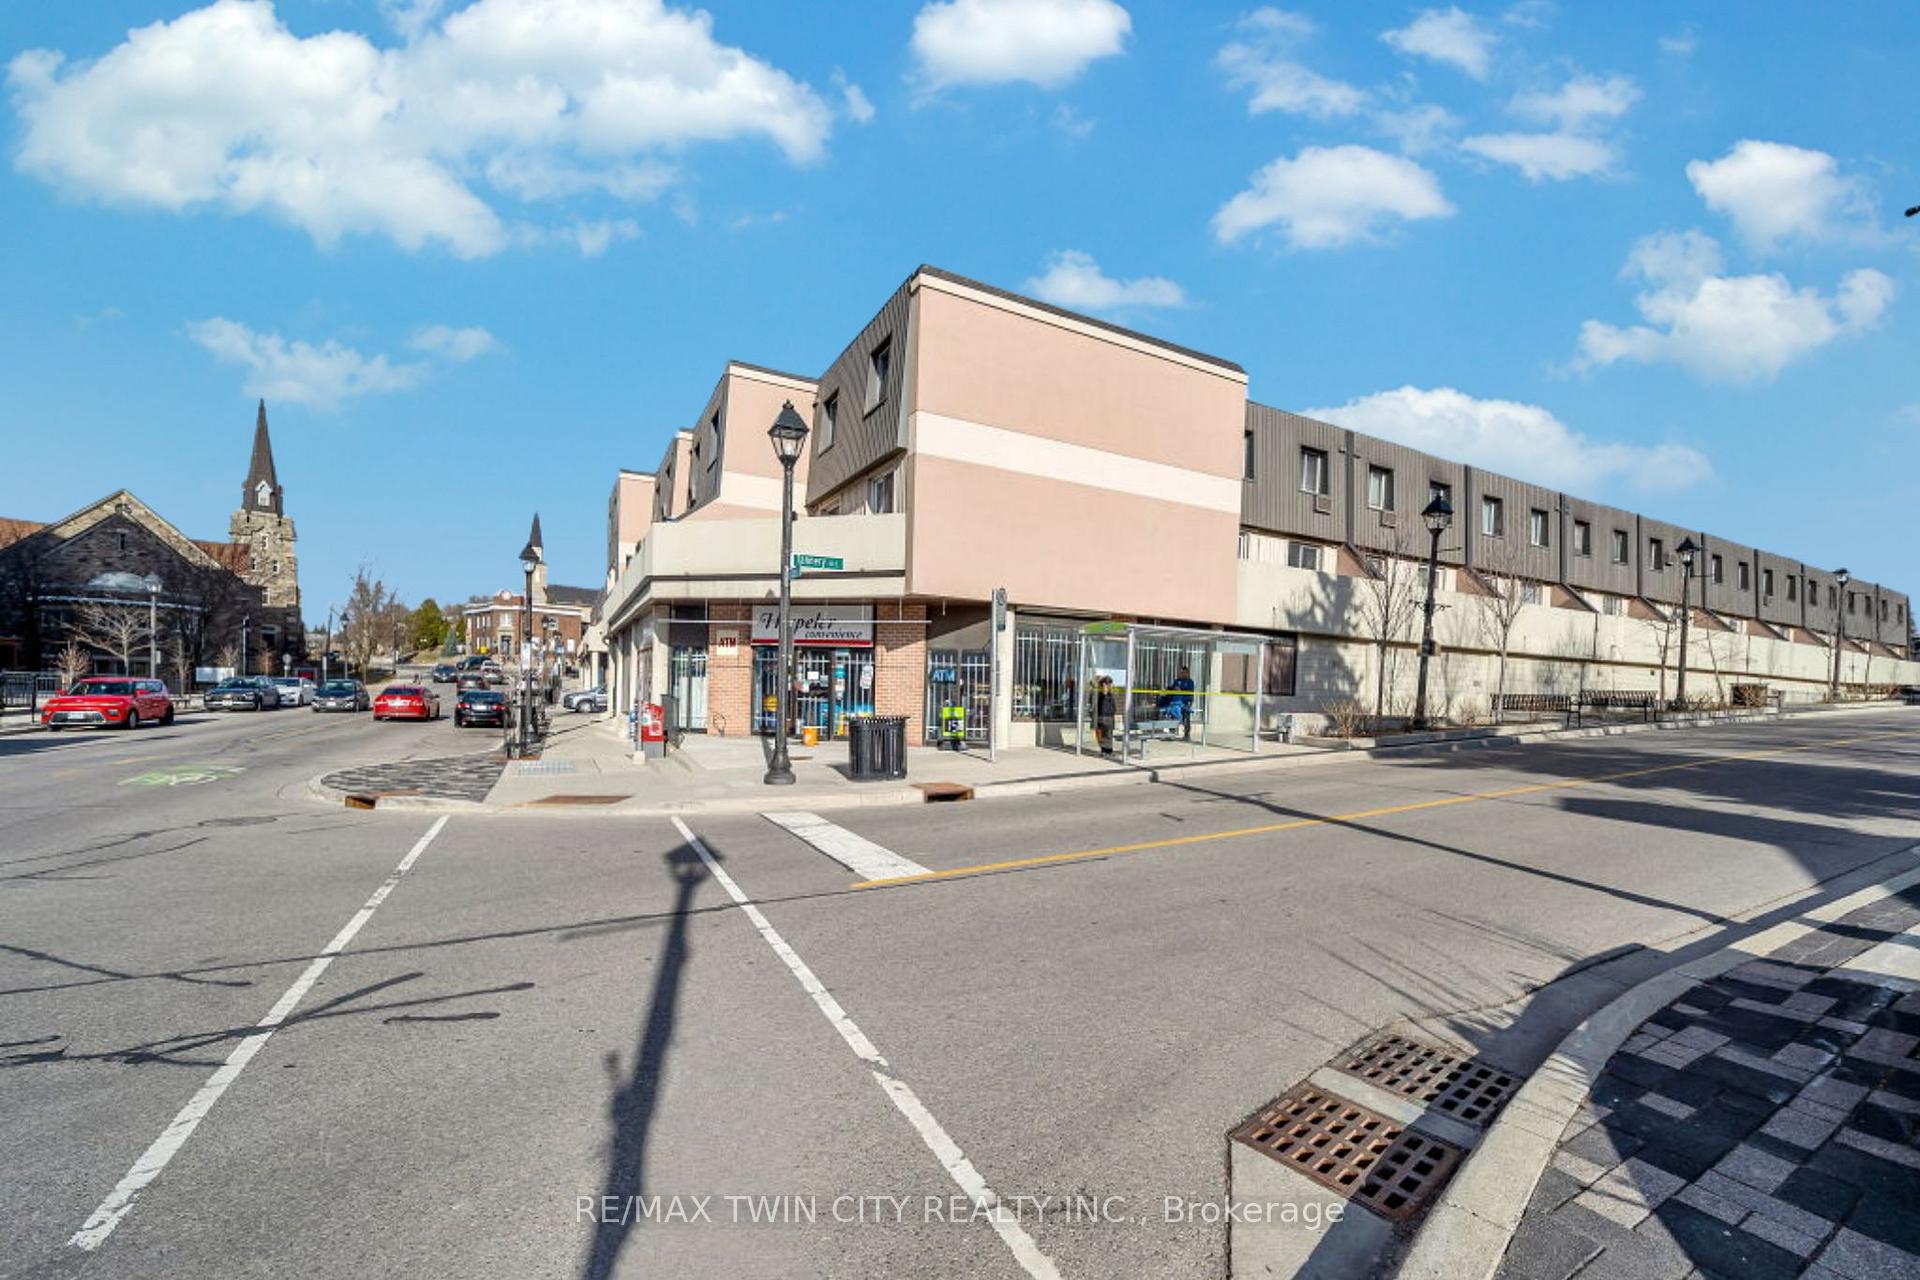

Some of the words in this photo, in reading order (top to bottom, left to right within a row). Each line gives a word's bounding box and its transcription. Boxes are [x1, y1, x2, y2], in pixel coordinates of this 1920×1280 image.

[760, 612, 837, 634] Hpeler
[804, 630, 862, 639] convenience
[719, 636, 737, 648] ATM
[932, 669, 955, 682] ATM
